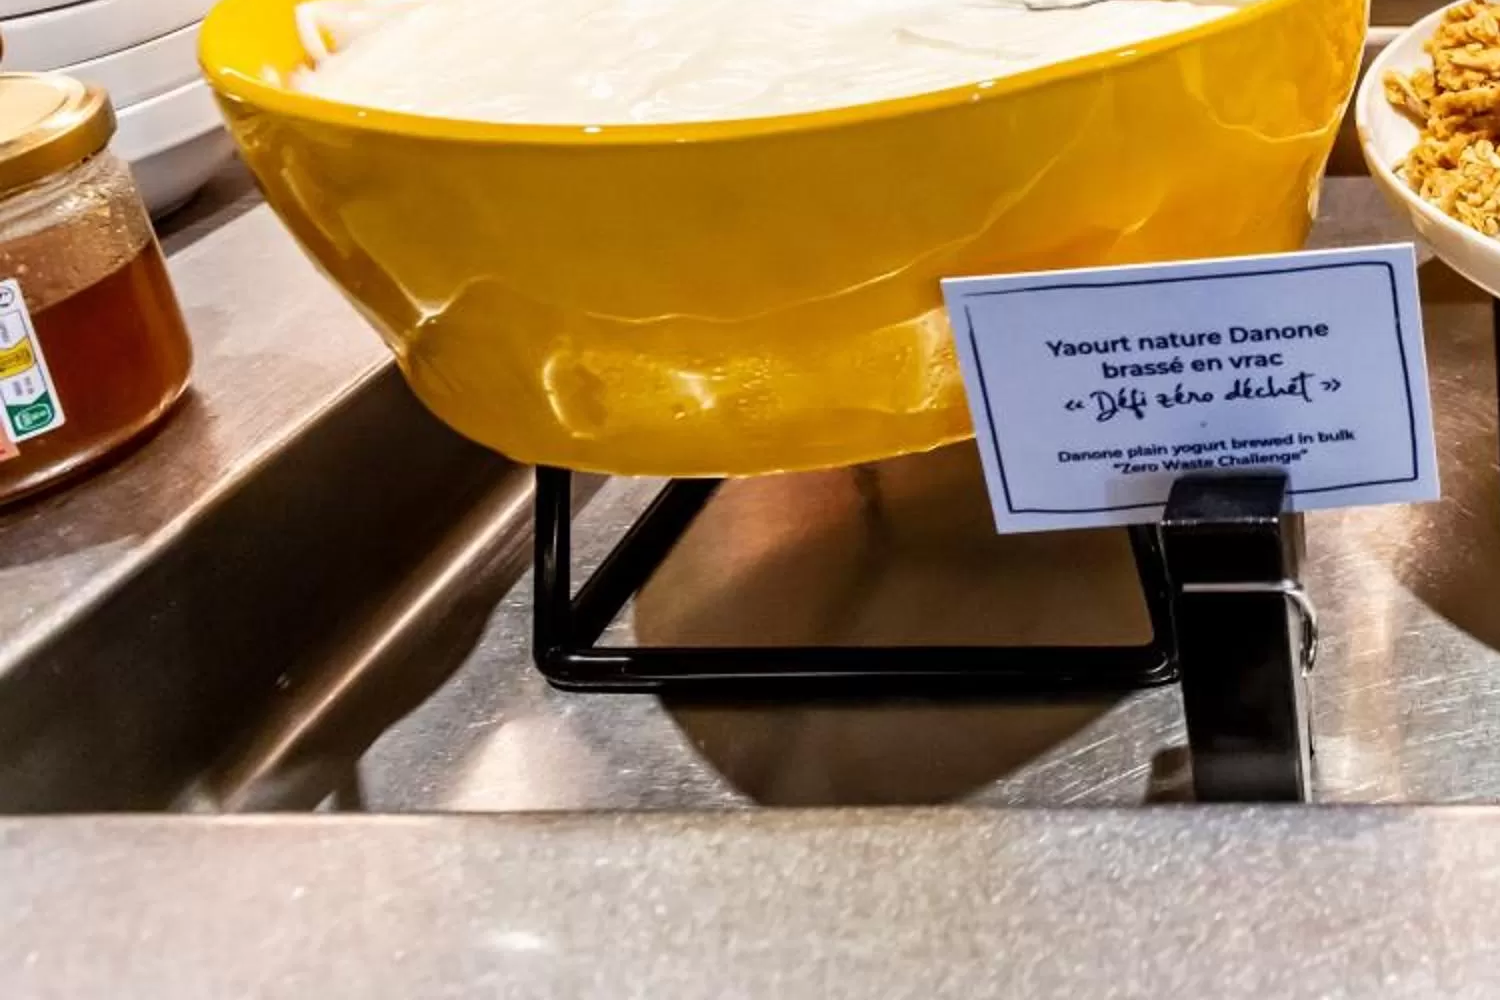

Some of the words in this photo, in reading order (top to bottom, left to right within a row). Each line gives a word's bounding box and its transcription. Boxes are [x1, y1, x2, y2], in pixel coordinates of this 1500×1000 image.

[1046, 335, 1132, 357] Yaourt
[1137, 331, 1222, 351] nature
[1228, 322, 1330, 345] Danone
[1101, 355, 1184, 379] brassé
[1190, 357, 1224, 373] en
[1227, 351, 1285, 370] vrac
[1089, 386, 1148, 423] Défi
[1156, 382, 1214, 409] zéro
[1224, 371, 1316, 403] déchet
[1057, 449, 1124, 463] Danone
[1126, 443, 1169, 459] plain
[1171, 439, 1227, 457] yogurt
[1230, 433, 1294, 450] brewed
[1297, 431, 1315, 445] in
[1316, 429, 1356, 443] bulk
[1161, 458, 1214, 472] Waste
